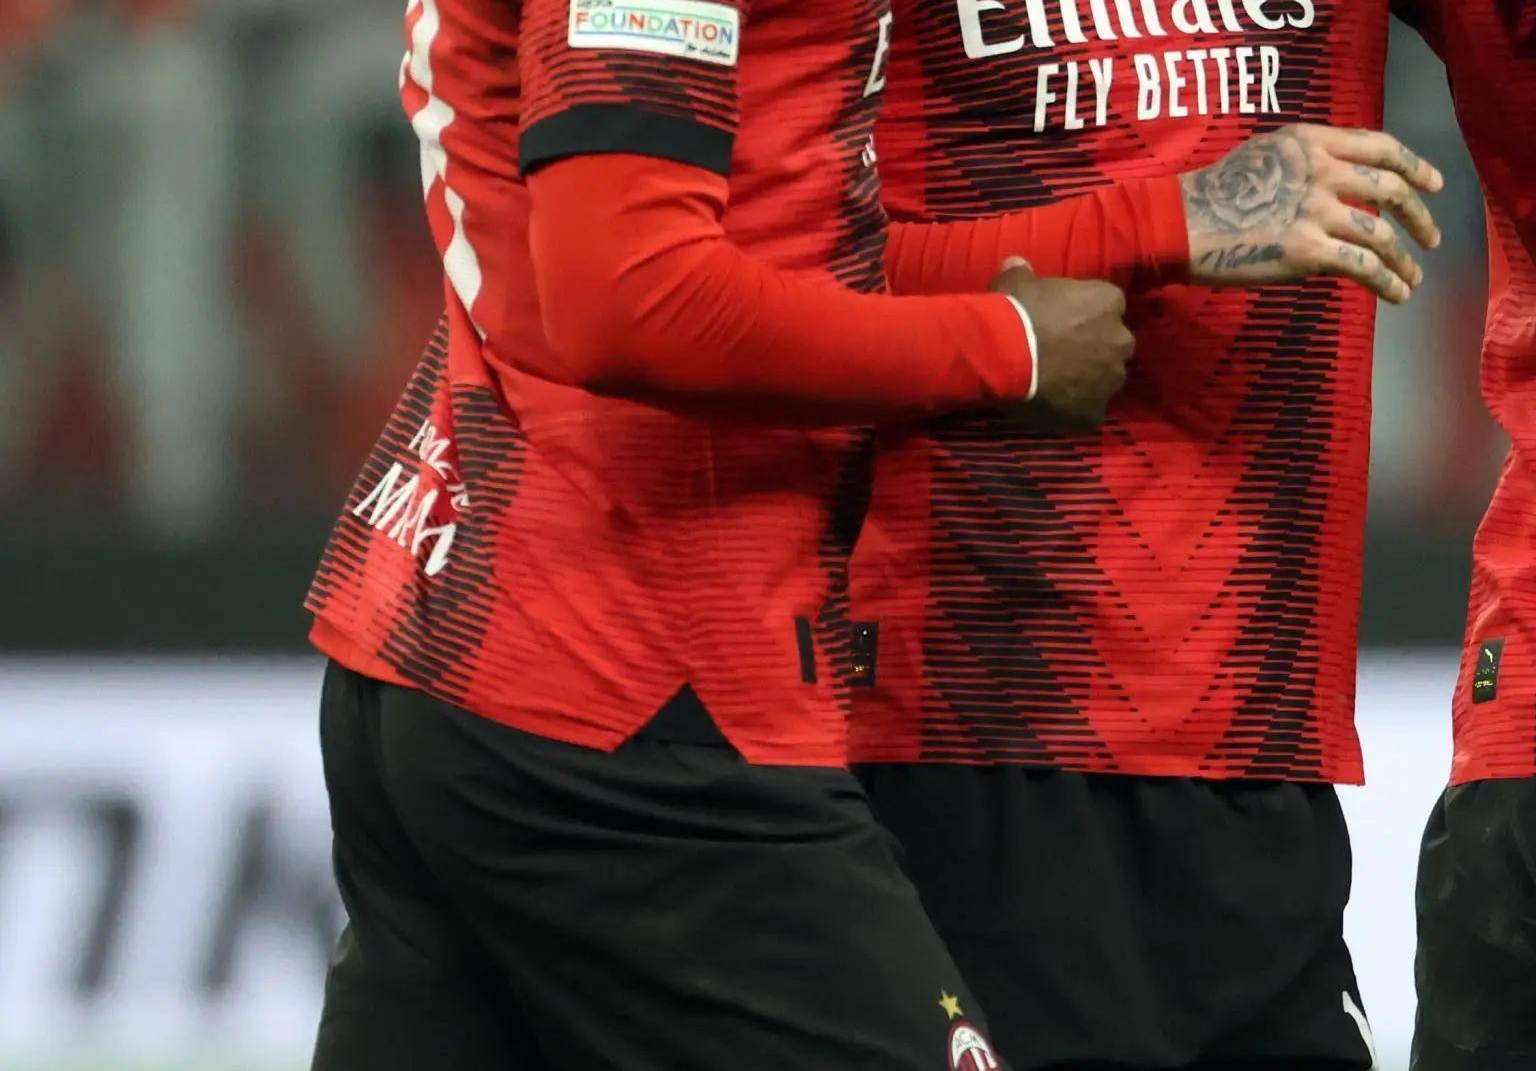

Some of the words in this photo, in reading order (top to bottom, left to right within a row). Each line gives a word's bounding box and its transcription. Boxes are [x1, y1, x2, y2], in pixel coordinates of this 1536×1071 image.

[575, 11, 733, 45] FOUNDATION
[1033, 56, 1113, 132] FLY
[1132, 46, 1281, 120] BETTER
